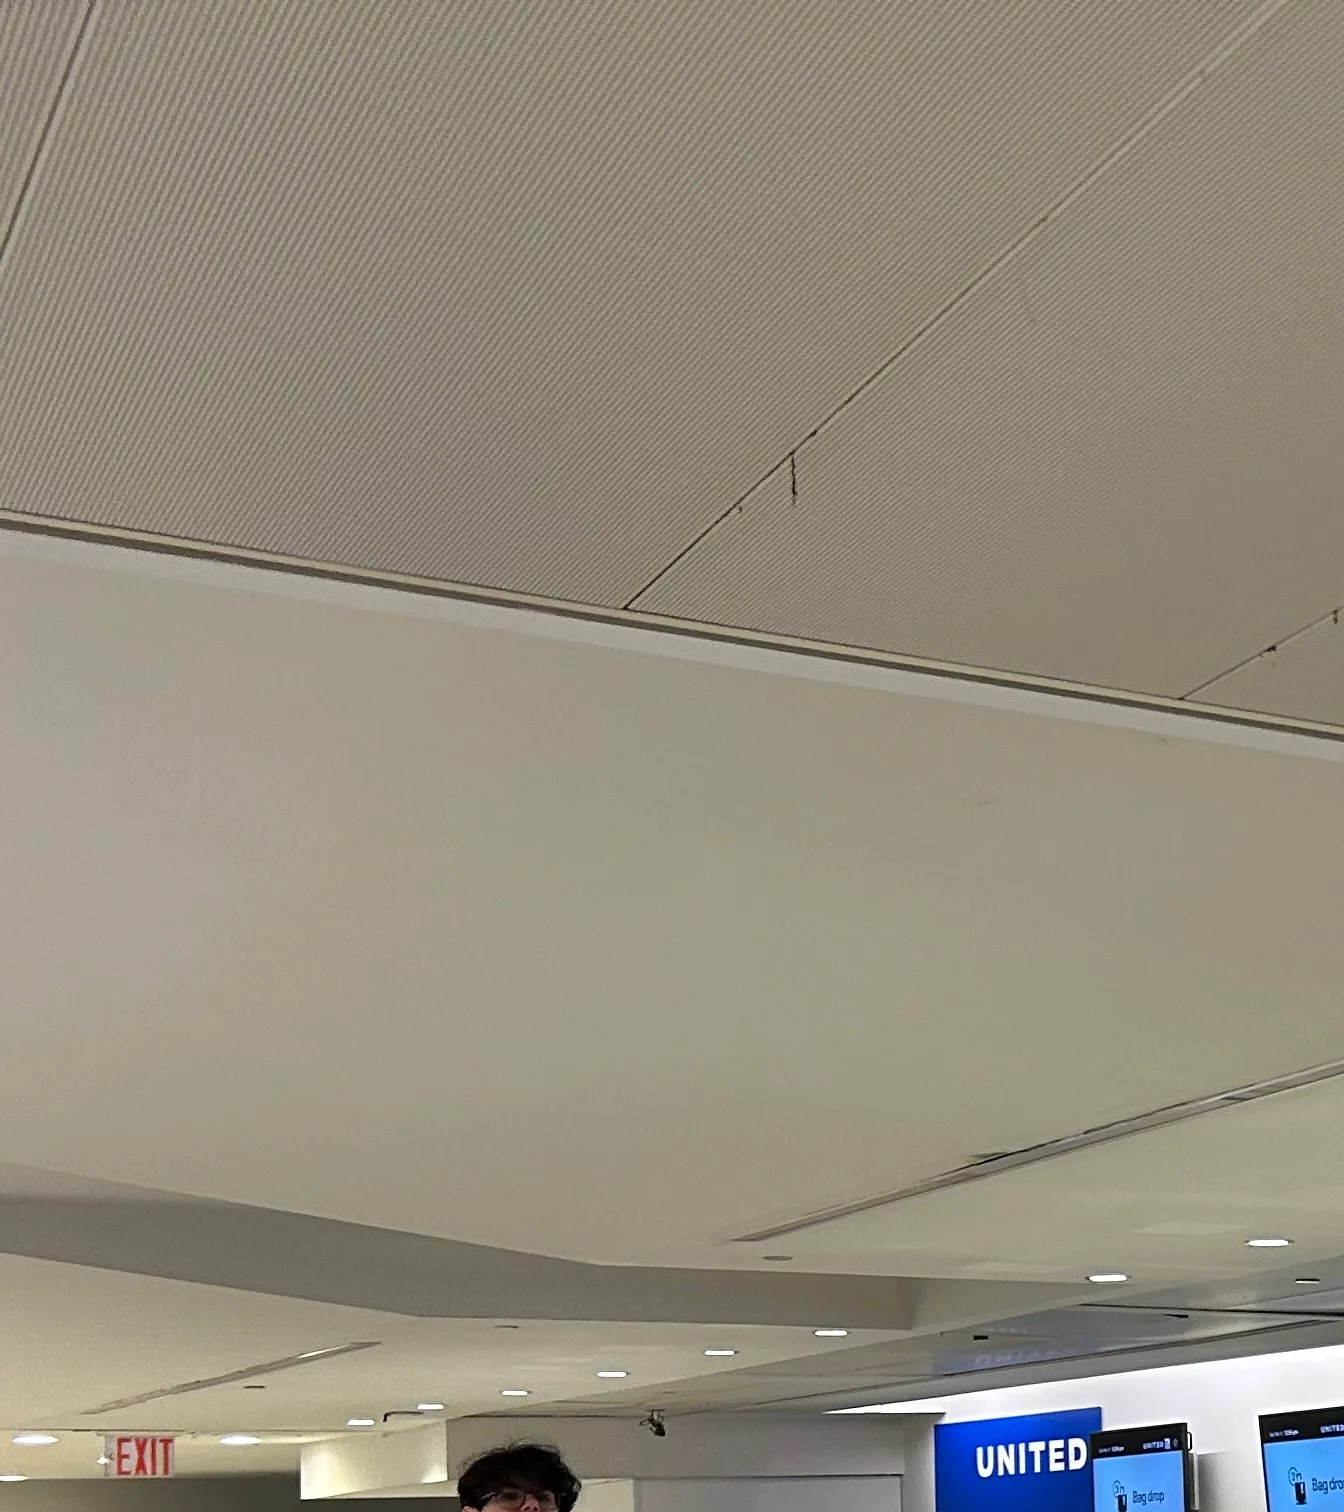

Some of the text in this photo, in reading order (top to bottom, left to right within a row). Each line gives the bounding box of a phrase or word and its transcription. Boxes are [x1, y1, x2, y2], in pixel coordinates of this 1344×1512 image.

[117, 1437, 173, 1476] EXIT
[975, 1437, 1088, 1478] UNITED
[1132, 1490, 1147, 1506] Bag
[1311, 1477, 1329, 1495] Bag
